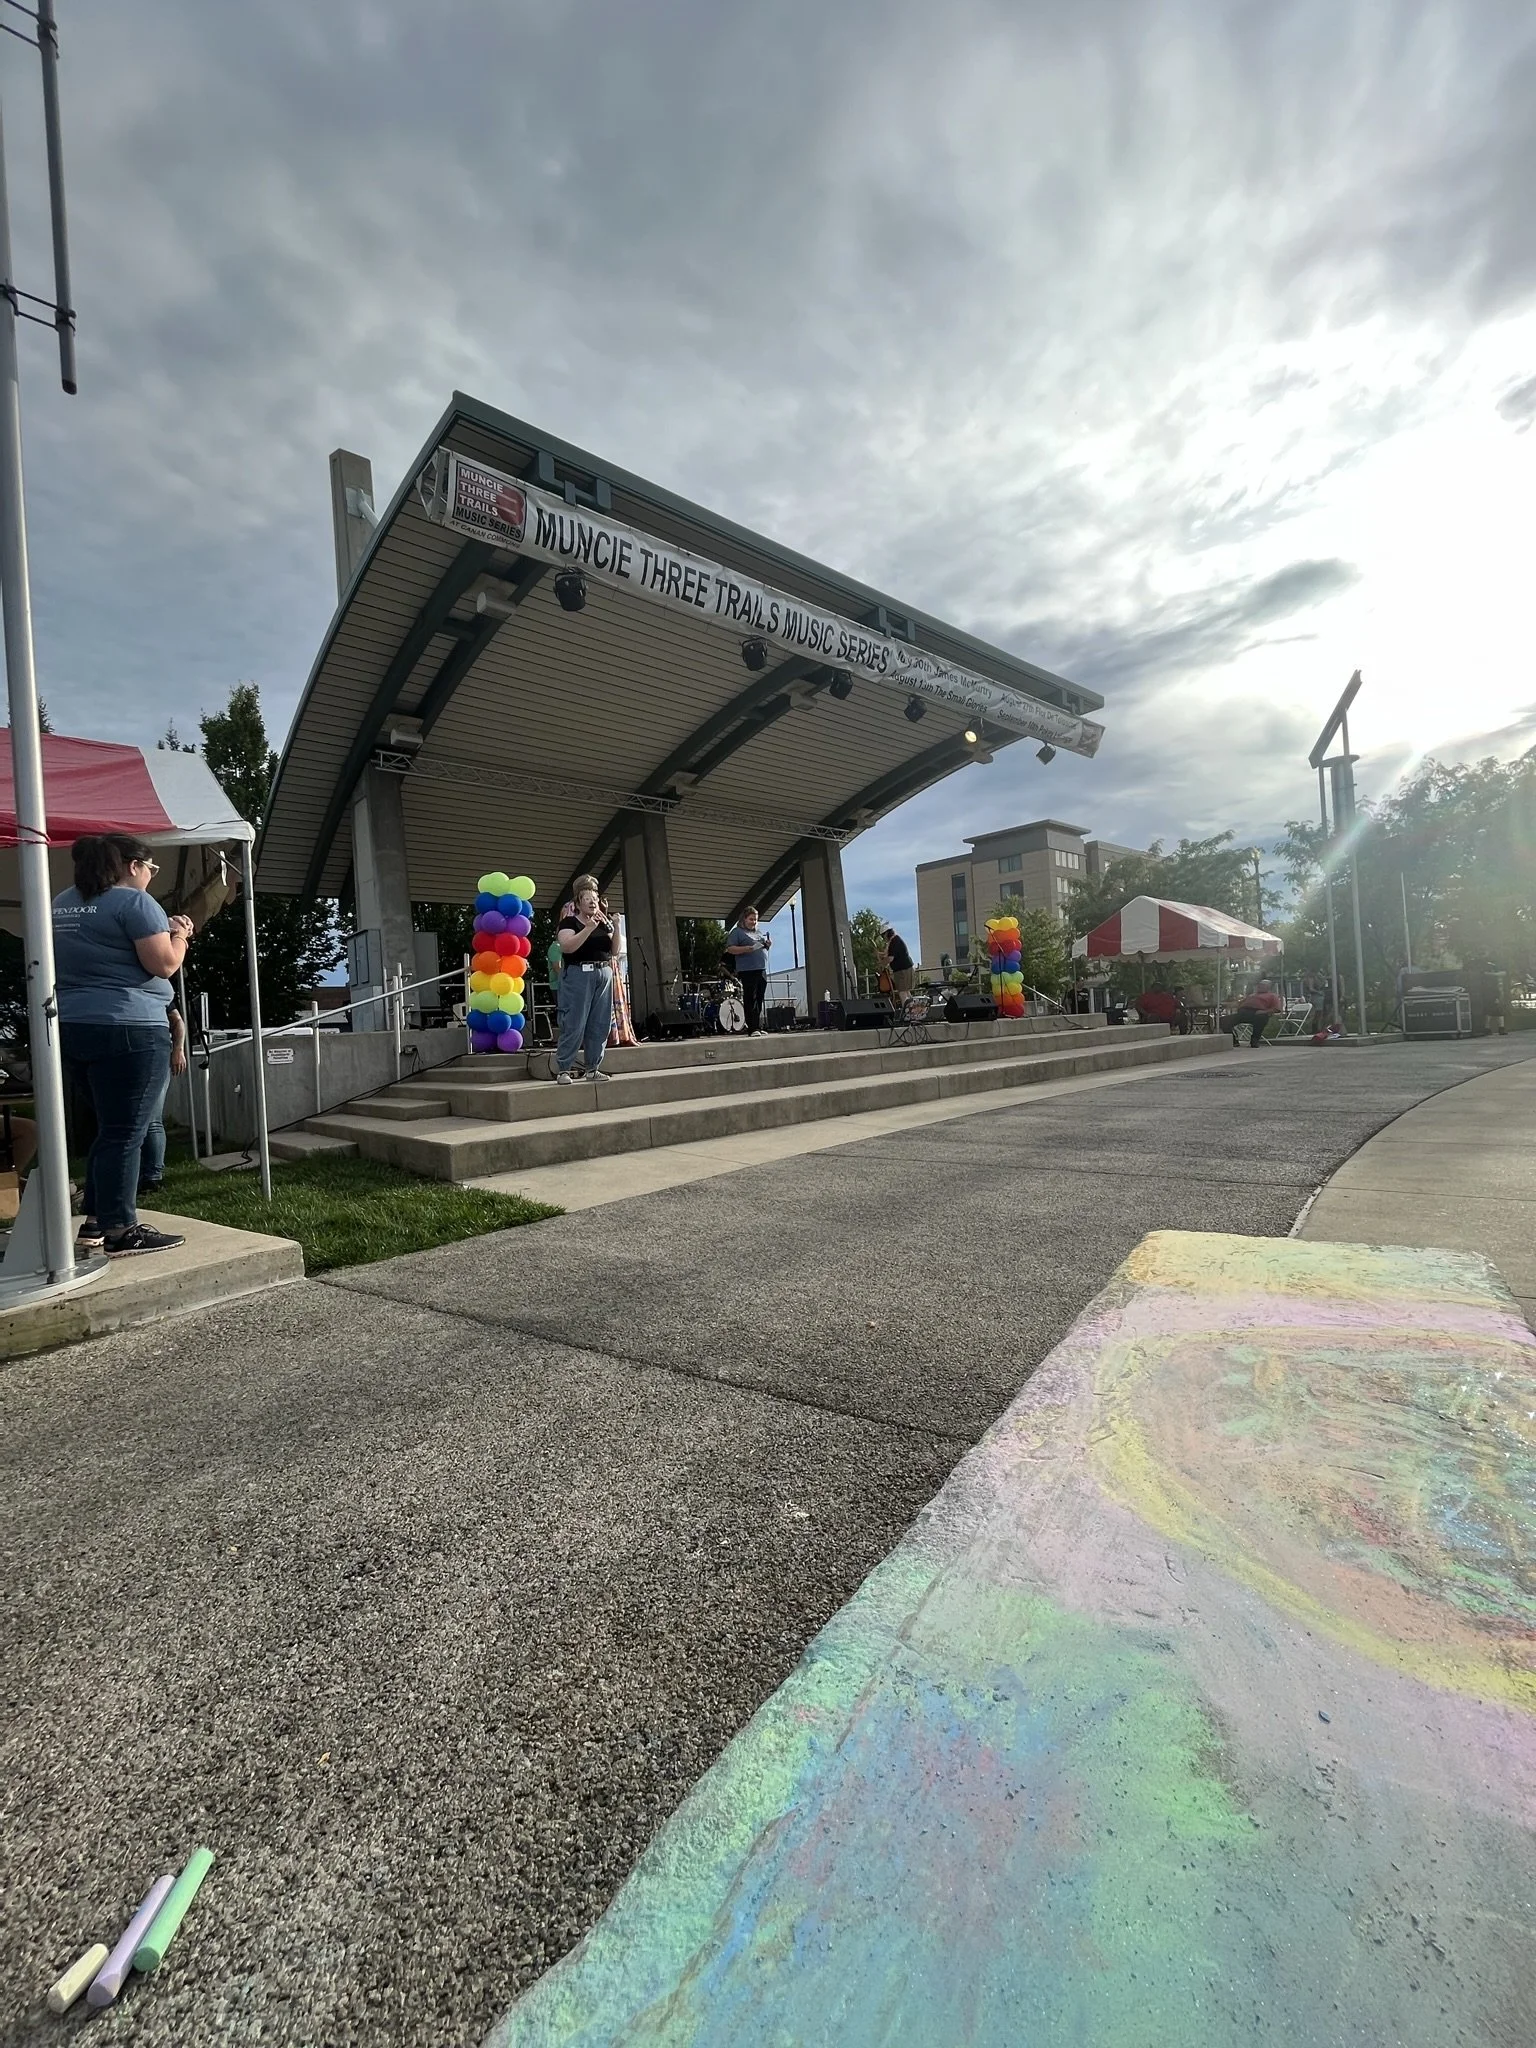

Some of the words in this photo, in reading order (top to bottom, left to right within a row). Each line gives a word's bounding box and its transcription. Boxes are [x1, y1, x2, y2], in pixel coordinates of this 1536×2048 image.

[460, 468, 504, 493] MUNCIE
[460, 481, 497, 503] THREE
[459, 494, 499, 517] TRAILS
[455, 506, 487, 526] MUSIC
[488, 519, 522, 539] SERIES
[461, 524, 487, 538] CANAN
[535, 507, 632, 579] MUNCIE
[639, 547, 711, 608] THREE
[715, 578, 780, 634] TRAILS
[781, 608, 835, 655] MUSIC
[837, 631, 890, 674] SERIES
[897, 650, 913, 669] Juy
[913, 657, 932, 673] 30th
[934, 666, 959, 684] James
[890, 669, 917, 688] August
[934, 684, 947, 698] The
